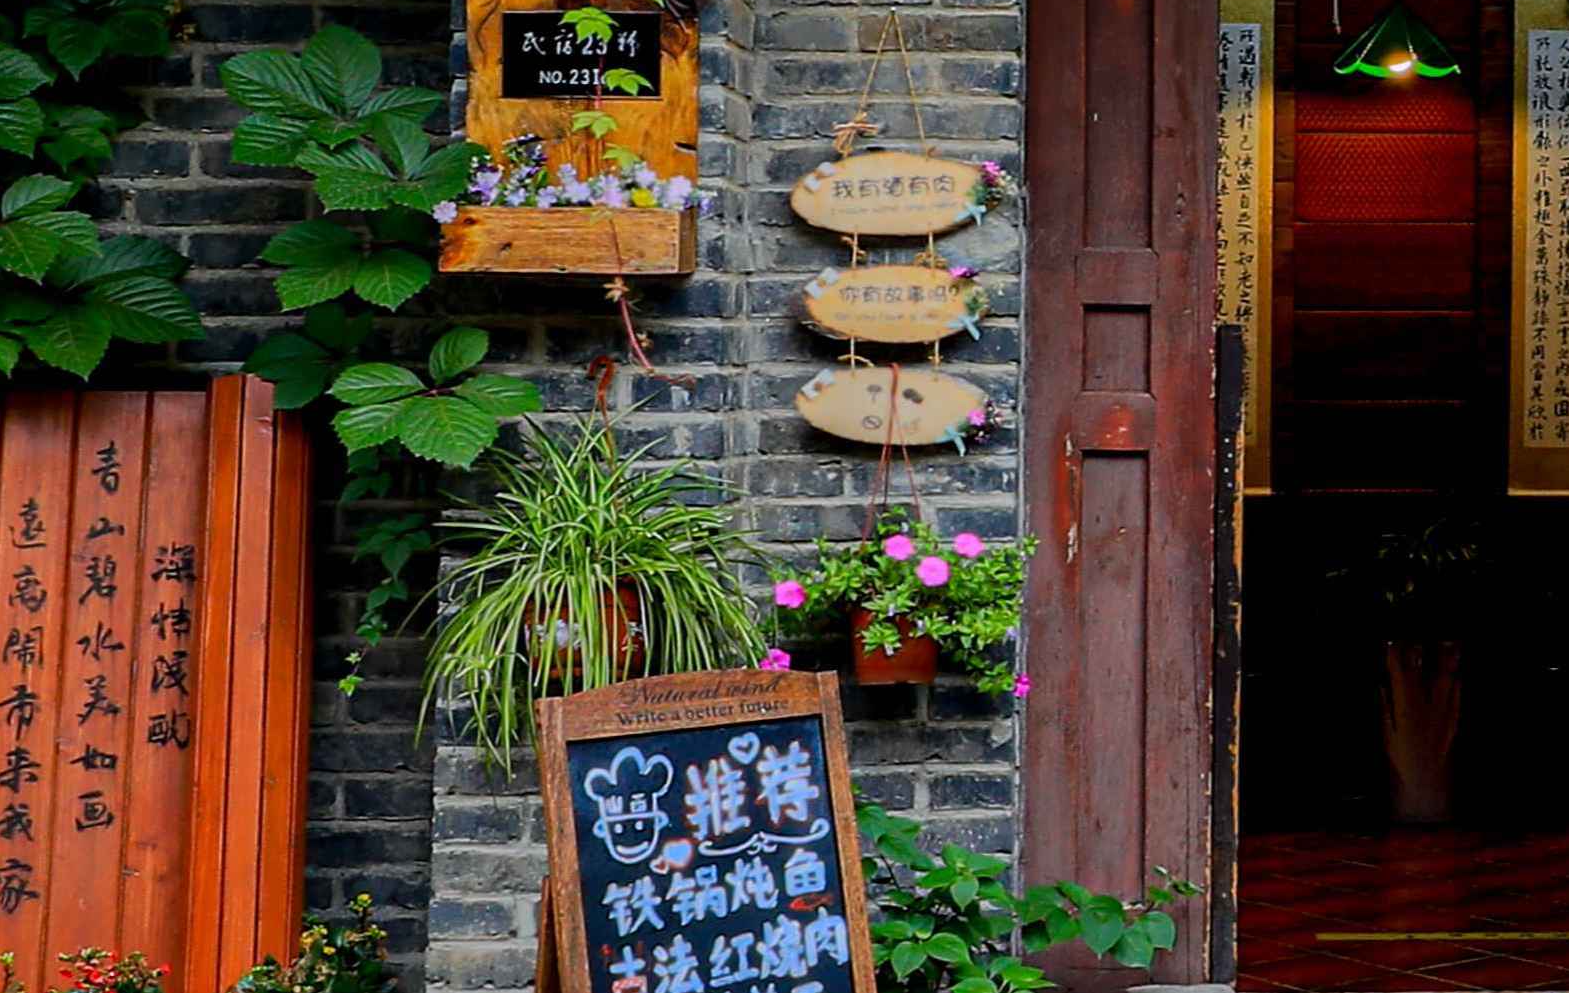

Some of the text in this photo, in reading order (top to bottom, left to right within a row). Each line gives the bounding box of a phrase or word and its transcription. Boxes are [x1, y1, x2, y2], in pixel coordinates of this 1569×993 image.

[614, 708, 666, 725] Write
[684, 740, 820, 840] 推荐
[603, 848, 827, 937] 铁锅炖鱼
